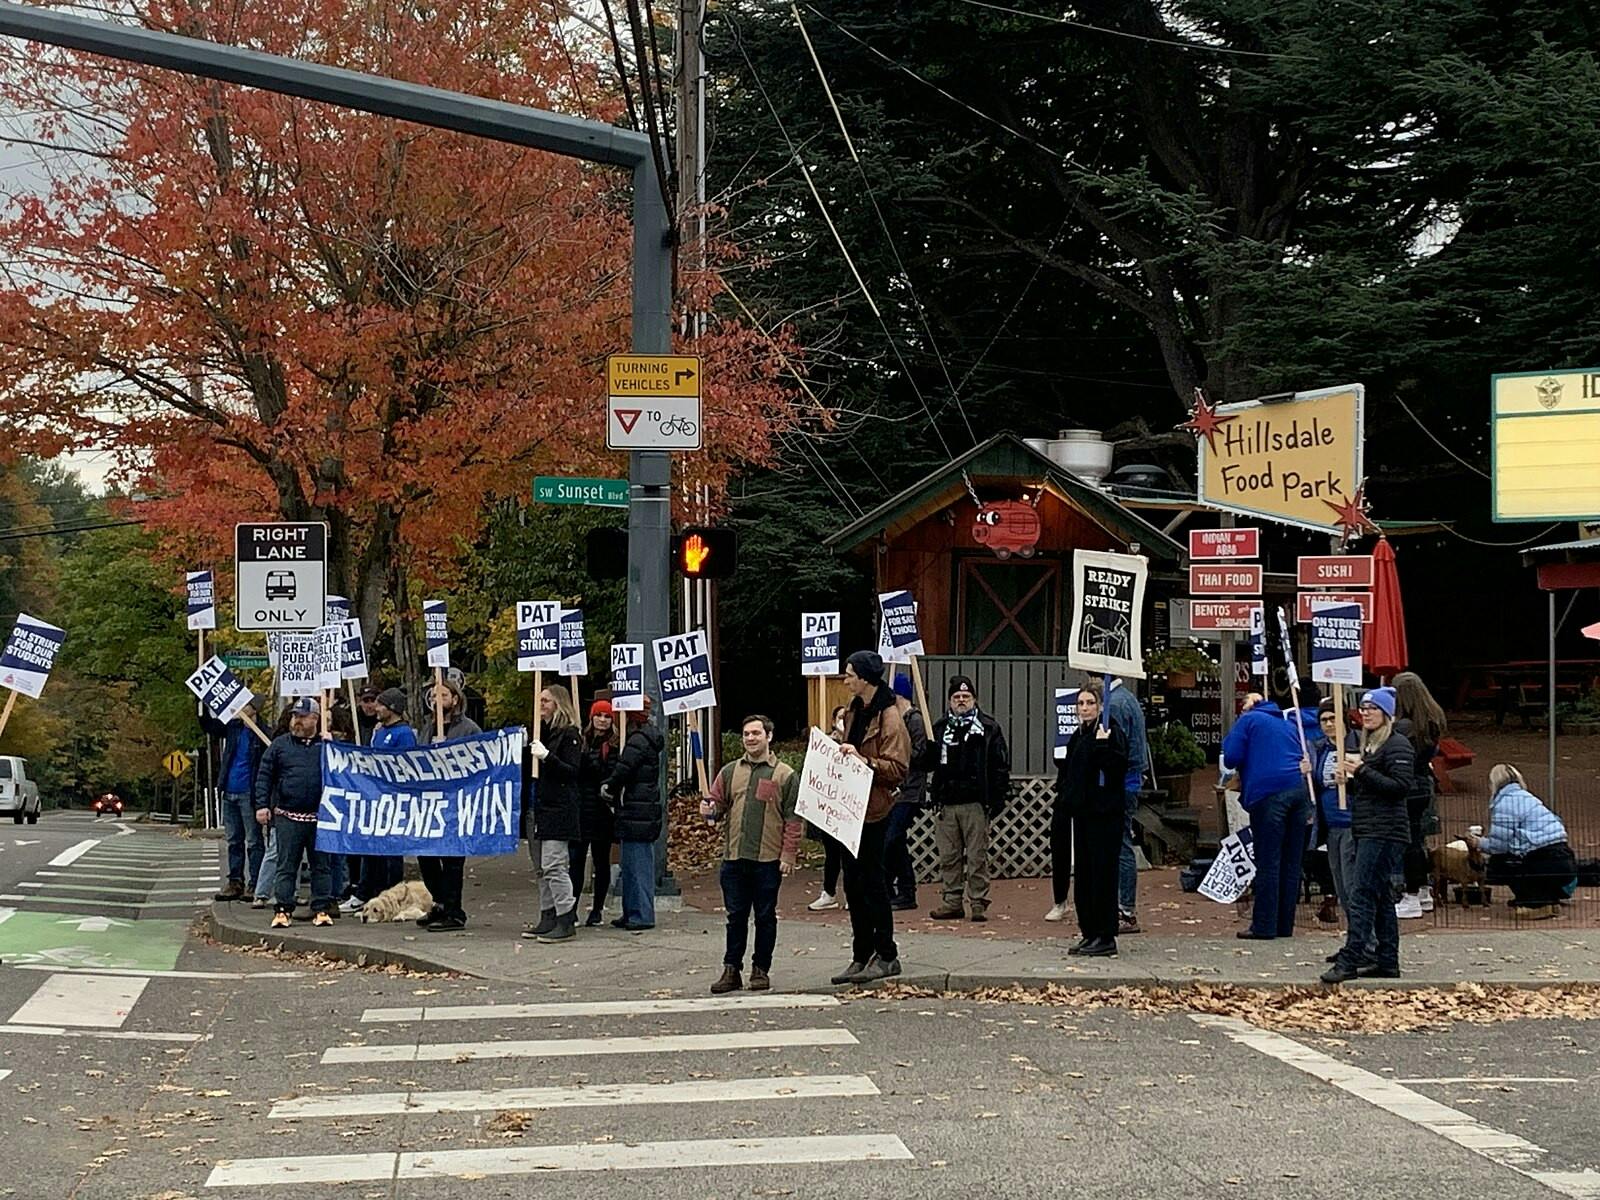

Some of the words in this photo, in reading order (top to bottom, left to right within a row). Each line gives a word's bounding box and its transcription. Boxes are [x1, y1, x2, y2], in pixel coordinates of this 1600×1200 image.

[616, 362, 668, 374] TURNING
[614, 379, 670, 391] VEHICLES
[646, 410, 662, 422] TO
[1224, 417, 1335, 457] Hillsdale
[1221, 461, 1274, 495] Food
[540, 487, 553, 498] SW
[557, 483, 604, 499] Sunset
[608, 492, 624, 500] Blvd
[253, 528, 309, 541] RIGHT
[1202, 533, 1231, 544] INDIAN
[256, 546, 307, 559] LANE
[1318, 565, 1353, 578] SUSHI
[1087, 569, 1131, 588] READY
[1198, 574, 1221, 586] THAI
[1225, 573, 1253, 586] FOOD
[1099, 584, 1117, 596] TO
[1084, 595, 1130, 613] STRIKE
[1194, 604, 1231, 616] BENTOS
[254, 609, 307, 622] ONLY
[521, 604, 555, 623] PAT
[806, 615, 836, 632] PAT
[888, 616, 901, 626] FOR
[1312, 616, 1328, 628] ON
[1328, 618, 1361, 630] STRIKE
[13, 628, 28, 640] ON
[27, 632, 61, 653] STRIKE
[530, 628, 544, 640] ON
[1318, 628, 1336, 638] FOR
[1338, 629, 1358, 640] OUR
[282, 642, 314, 653] GREA
[520, 638, 557, 651] STRIKE
[658, 635, 699, 662] PAT
[814, 638, 828, 646] ON
[1313, 637, 1361, 650] STUDENTS
[14, 638, 34, 652] FOR
[34, 646, 54, 660] OUR
[804, 646, 837, 657] STRIKE
[6, 645, 53, 669] STUDENTS
[282, 653, 314, 664] PUBLI
[613, 647, 636, 665] PAT
[324, 662, 339, 672] ALL
[674, 664, 692, 678] ON
[191, 660, 221, 692] PAT
[282, 672, 302, 680] FOR
[616, 670, 626, 680] ON
[211, 680, 226, 696] ON
[663, 672, 709, 692] STRIKE
[209, 679, 241, 710] STRIKE
[1058, 714, 1072, 724] FOR
[1192, 713, 1210, 728] (503)
[826, 764, 842, 781] the
[808, 769, 839, 798] World
[317, 785, 449, 838] STUDENTS
[1226, 841, 1251, 878] PAT
